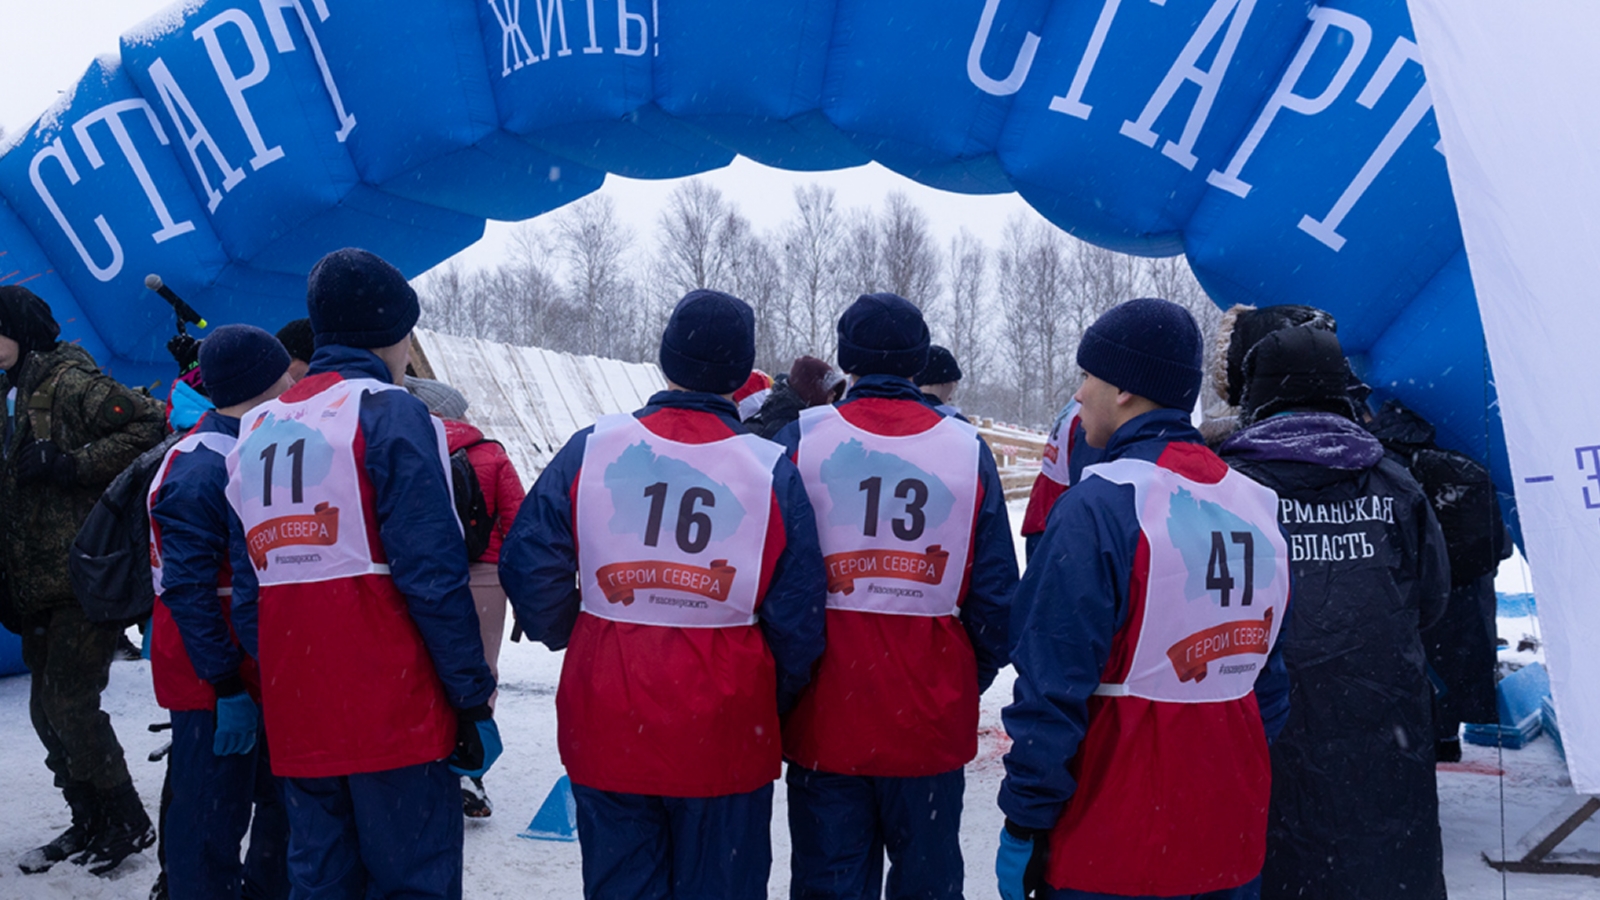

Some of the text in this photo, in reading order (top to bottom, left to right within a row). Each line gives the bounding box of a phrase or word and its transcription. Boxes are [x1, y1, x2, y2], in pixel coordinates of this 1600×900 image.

[488, 0, 659, 77] ЖИТЬ!
[28, 0, 357, 283] СТАРТ
[259, 438, 305, 507] 11
[248, 521, 329, 554] ГЕРОИ СЕВЕРА
[643, 482, 716, 554] 16
[858, 476, 929, 541] 13
[607, 568, 721, 594] ГЕРОИ СЕВЕРА
[829, 555, 936, 577] ГЕРОИ СЕВЕРА
[1205, 531, 1254, 607] 47
[1185, 627, 1270, 662] ГЕРОИ СЕВЕРА
